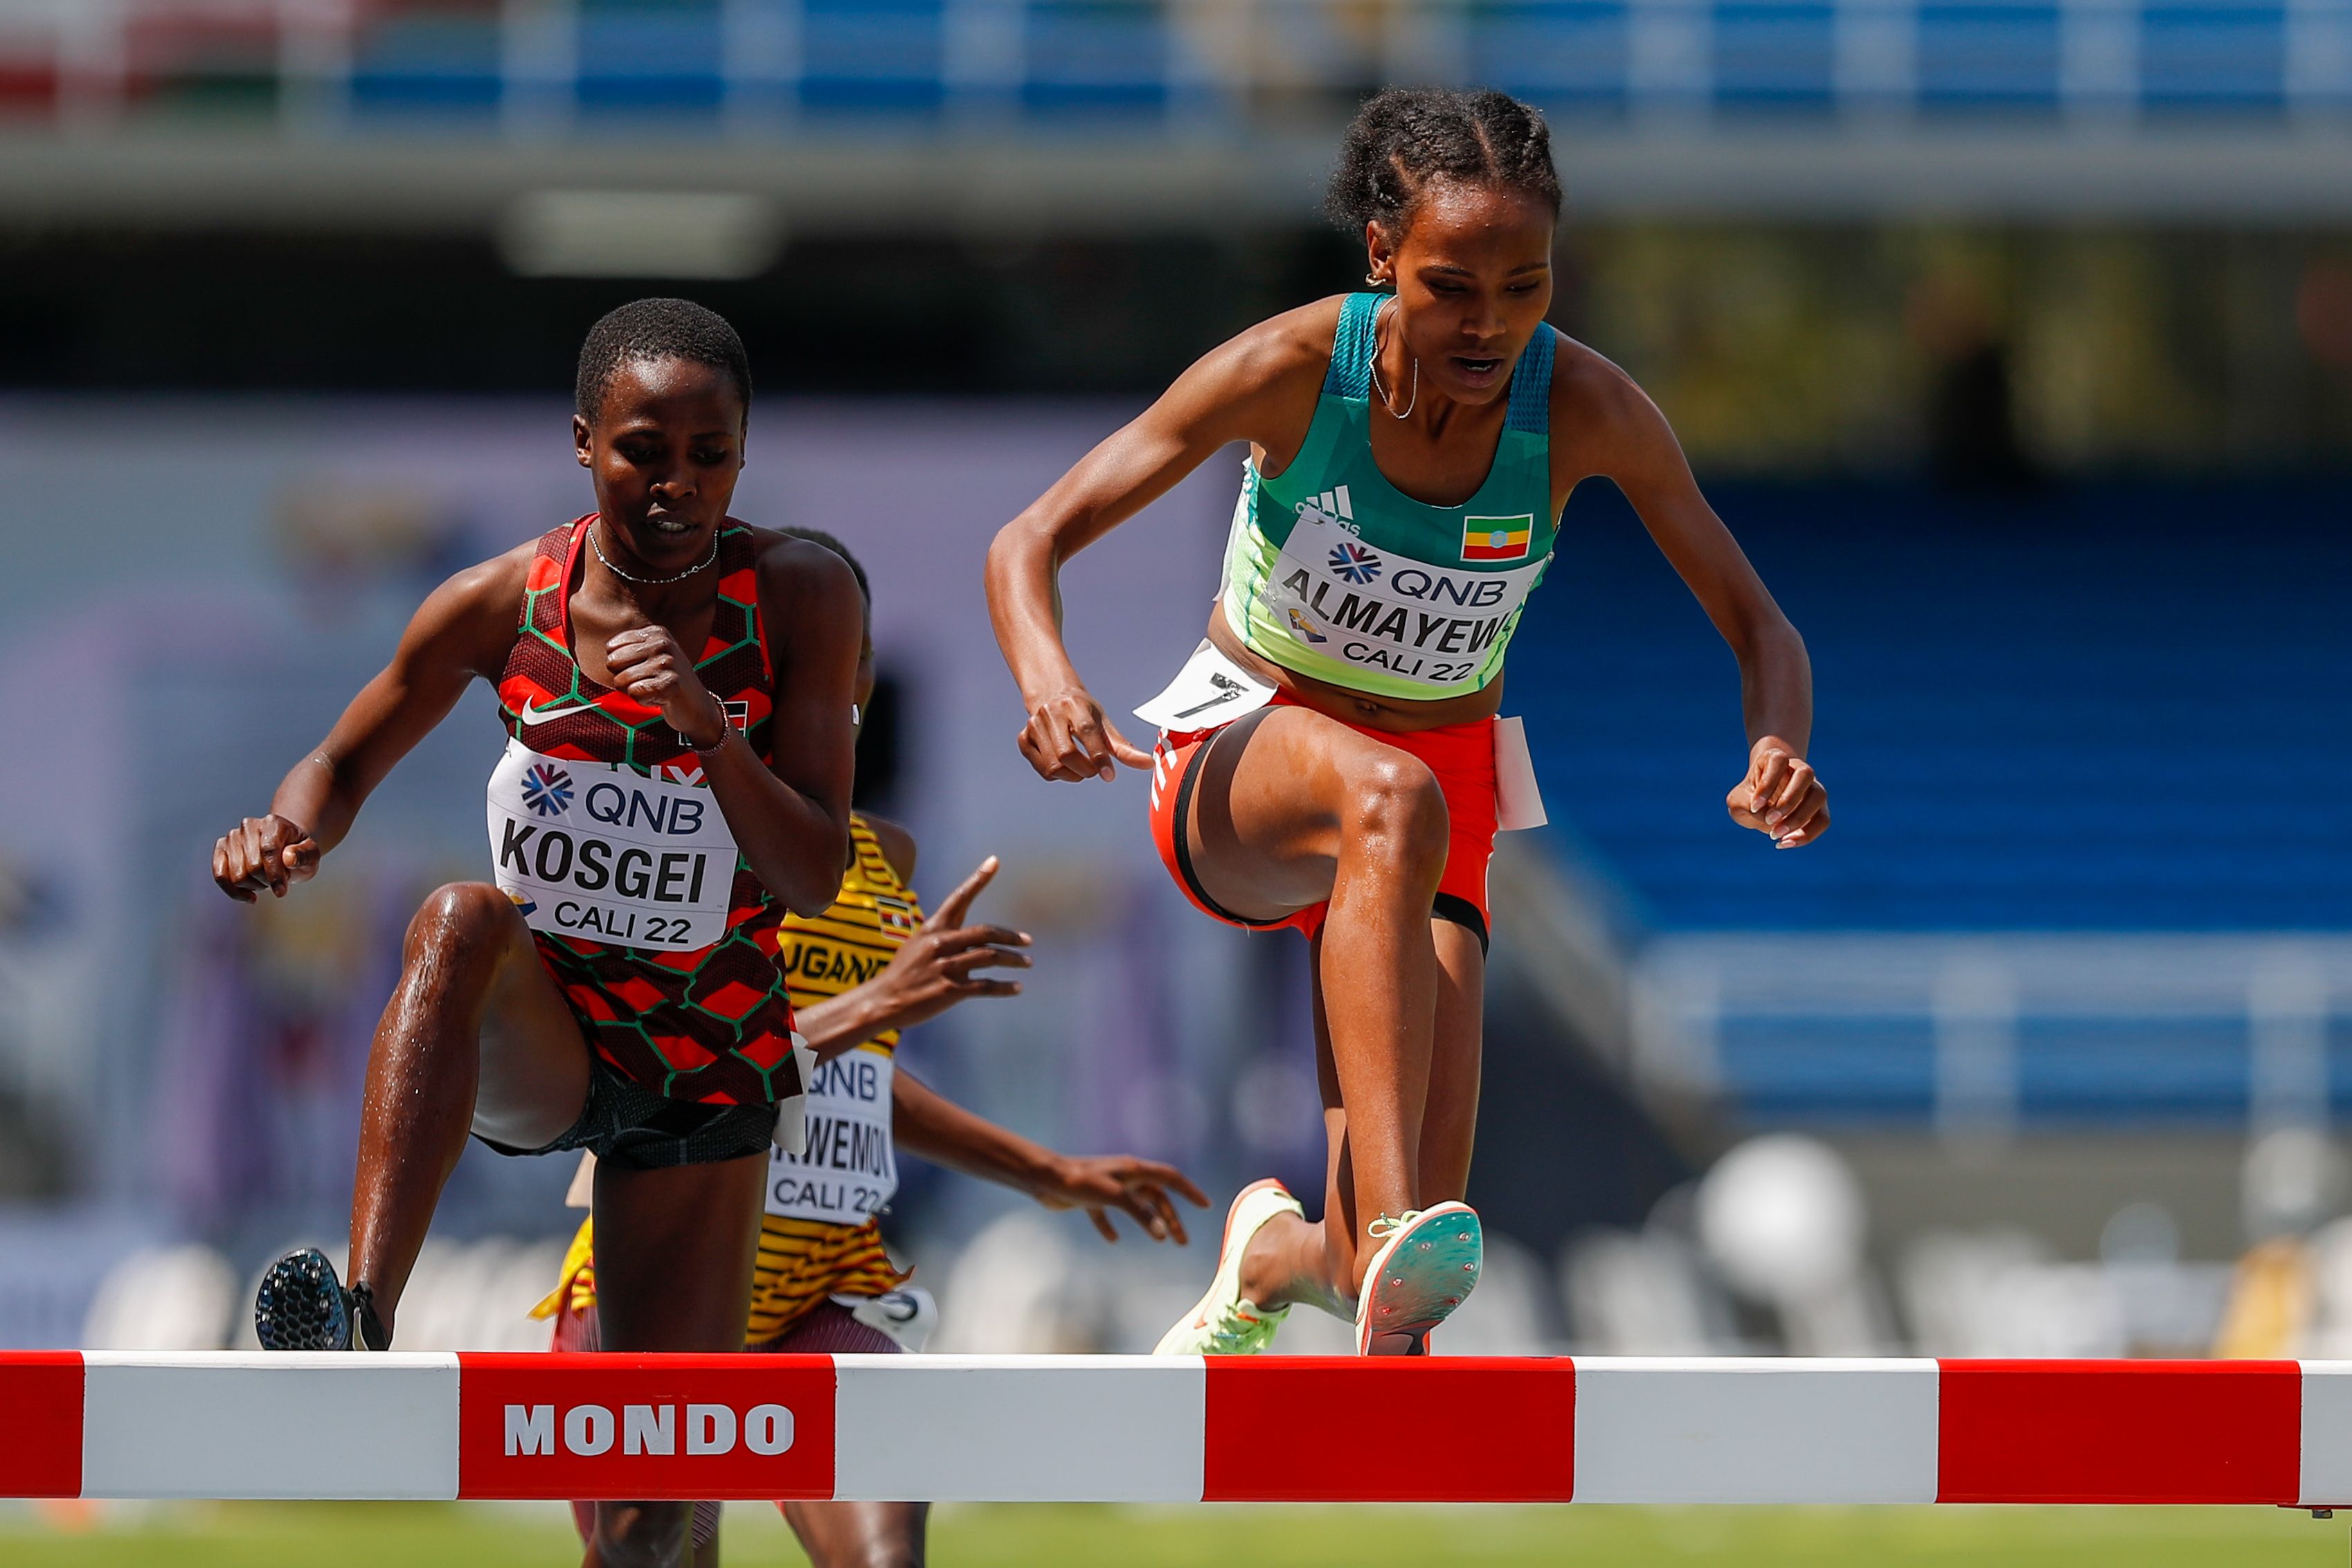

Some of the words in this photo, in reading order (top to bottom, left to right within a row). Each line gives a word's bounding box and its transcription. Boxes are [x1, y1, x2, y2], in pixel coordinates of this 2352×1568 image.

[1282, 568, 1510, 654] ALMAYEW
[1391, 570, 1507, 607] QNB
[1343, 642, 1423, 676] CALI
[1428, 663, 1475, 681] 22
[1174, 672, 1250, 719] 7
[585, 782, 704, 835] QNB
[500, 818, 707, 903] KOSGEI
[554, 901, 636, 938] CALI
[644, 917, 691, 944] 22
[774, 1180, 844, 1211] CALI
[504, 1403, 795, 1456] MONDO
